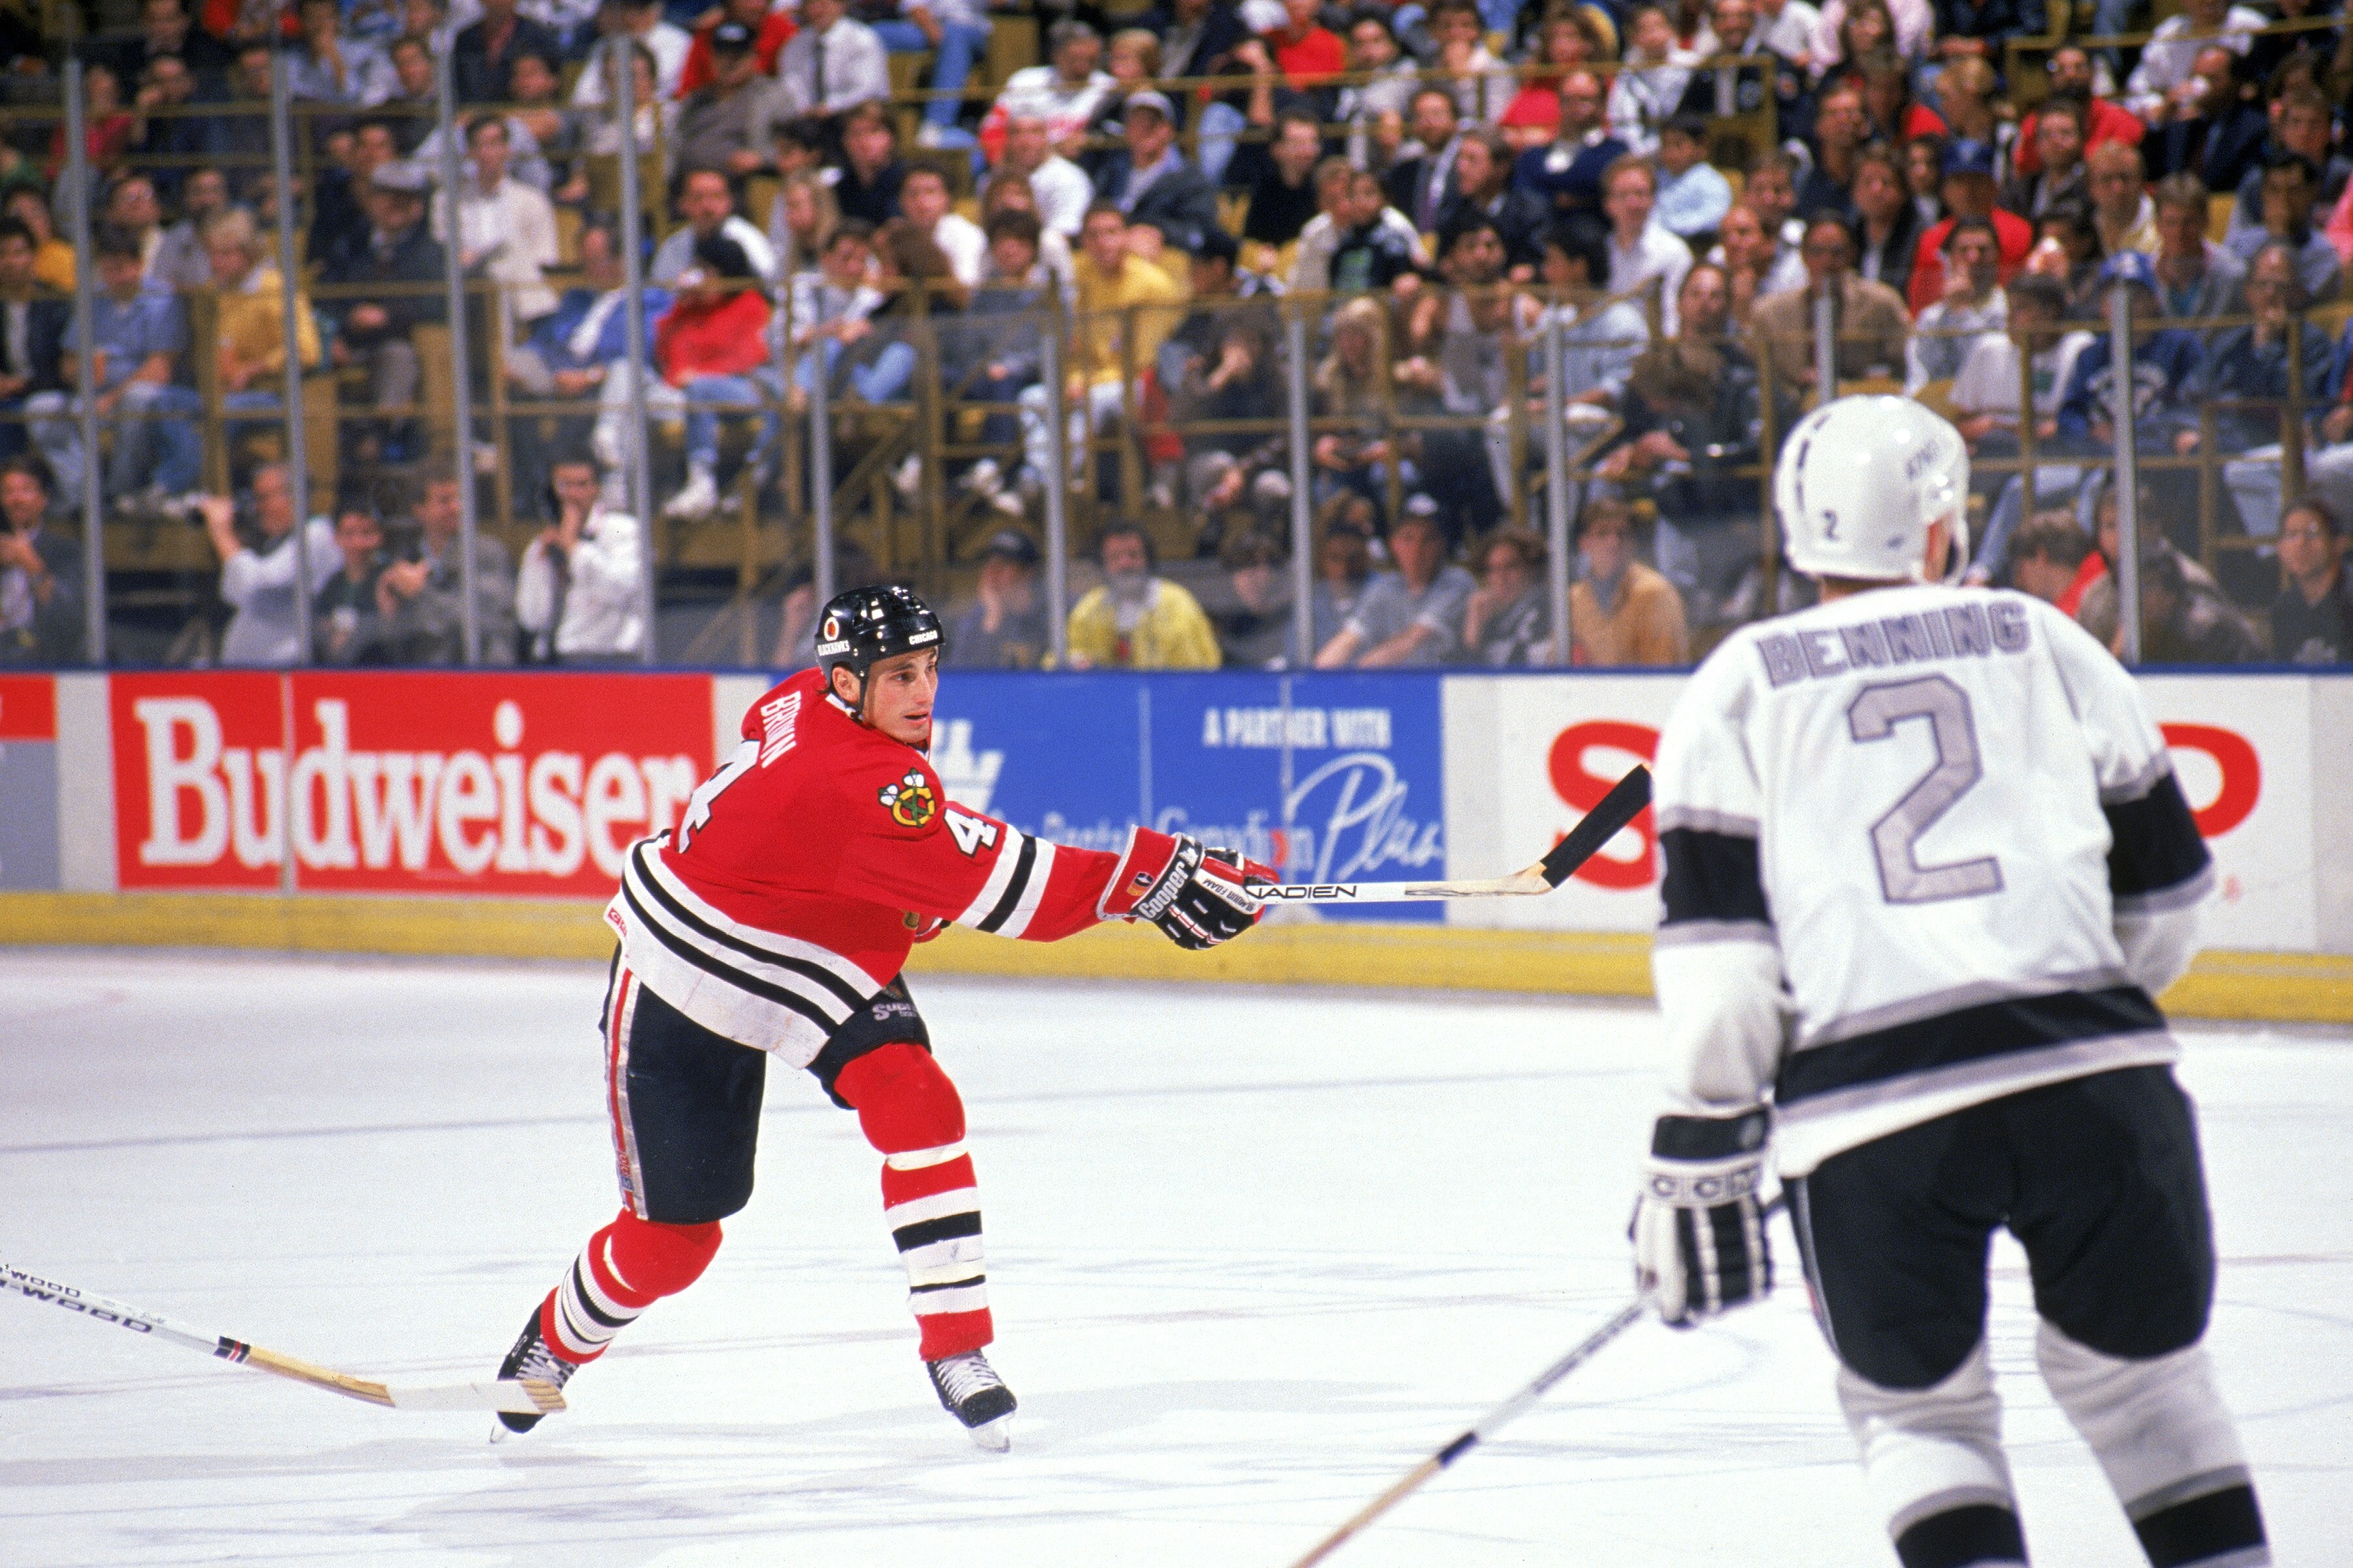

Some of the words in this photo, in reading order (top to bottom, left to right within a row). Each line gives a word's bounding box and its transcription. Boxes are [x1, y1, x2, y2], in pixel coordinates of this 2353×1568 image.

[1822, 510, 1840, 541] 2
[817, 640, 850, 656] BLACKHAWKS
[909, 630, 938, 645] CHICAGO
[1756, 601, 2032, 689] BENNING
[761, 691, 801, 768] BROWN
[1203, 708, 1221, 748] A
[1225, 708, 1328, 748] PARTNER
[1332, 707, 1392, 748] WITH
[135, 695, 697, 878] Budweiser
[1847, 673, 2006, 905] 2
[943, 807, 998, 858] 4
[1282, 751, 1445, 885] Plus
[1138, 861, 1188, 919] Cooper
[1202, 879, 1227, 895] FOAM
[1246, 885, 1357, 899] NADIEN
[0, 1267, 80, 1298] -WOOD
